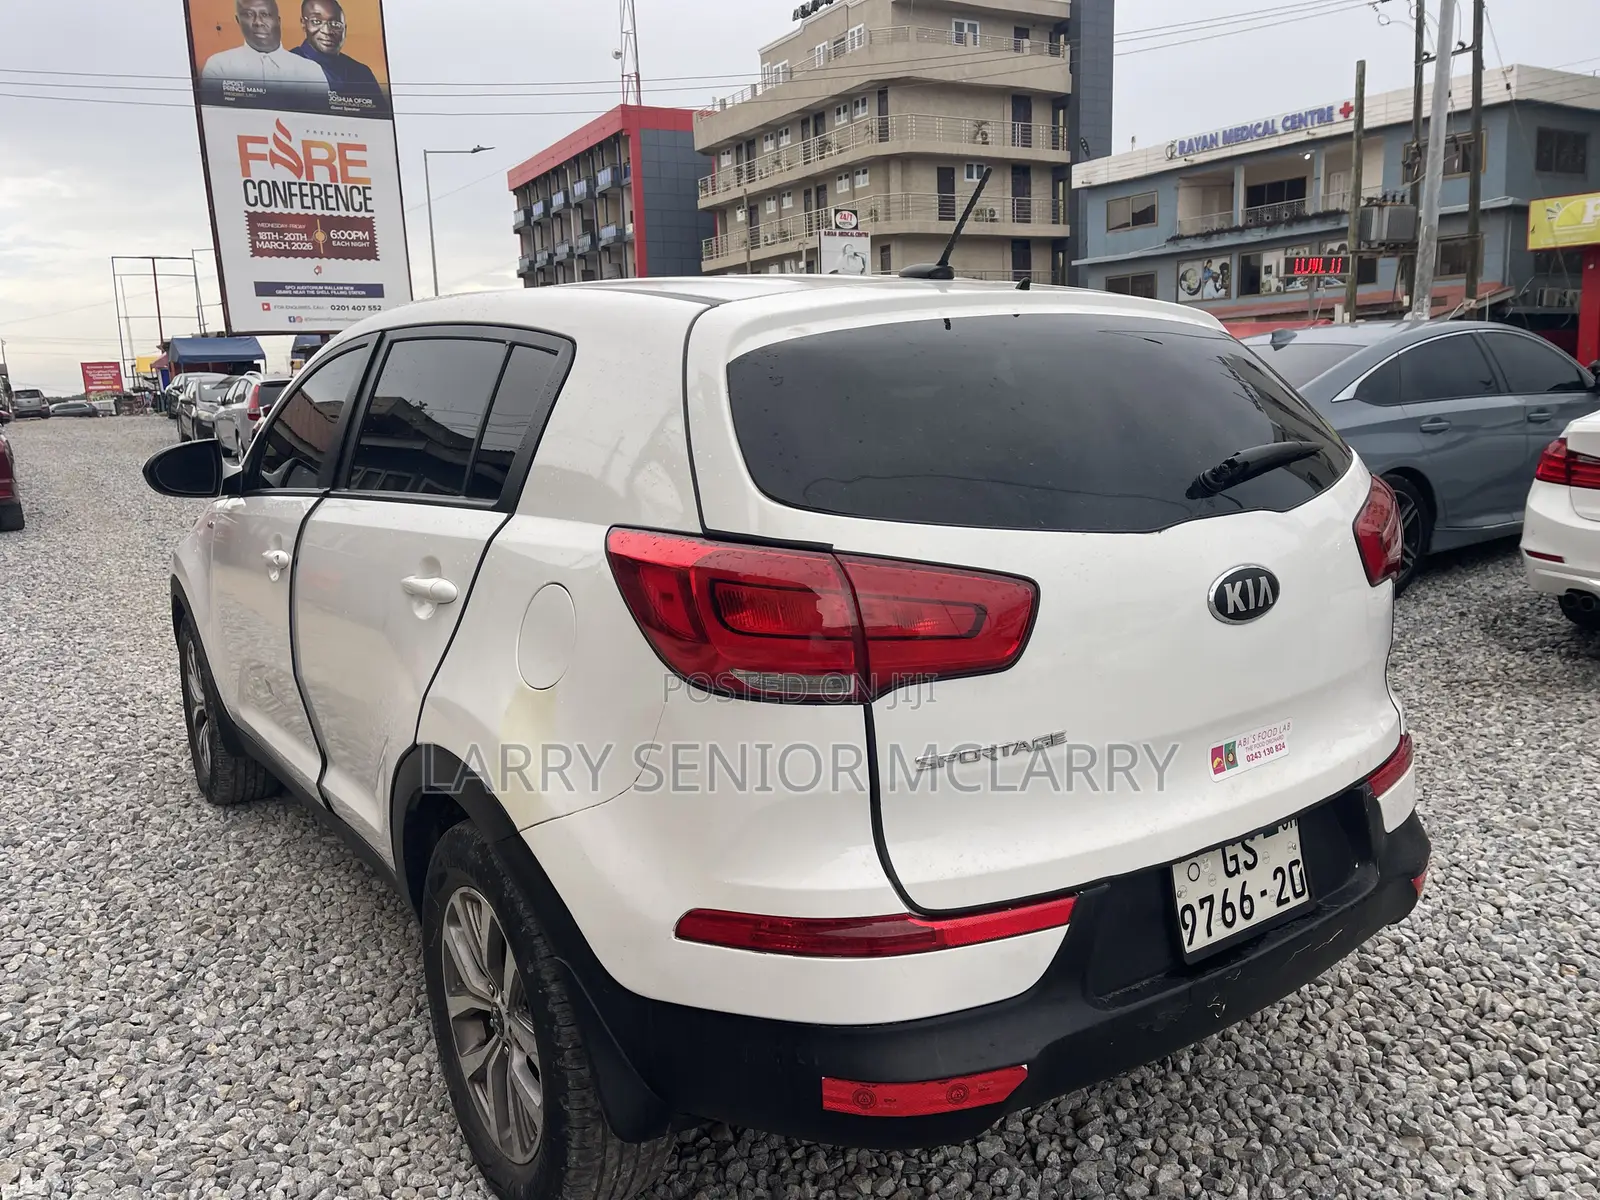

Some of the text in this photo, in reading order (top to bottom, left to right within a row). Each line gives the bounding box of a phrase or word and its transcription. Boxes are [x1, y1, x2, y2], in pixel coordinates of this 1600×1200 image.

[329, 95, 354, 103] JOSHUA
[353, 97, 373, 105] OFORI
[306, 129, 359, 138] PRESENTS
[1178, 105, 1335, 156] RAYAN MEDICAL CENTRE
[243, 179, 374, 212] CONFERENCE
[840, 213, 852, 221] 24/7
[330, 229, 370, 241] 6:00PM
[291, 242, 314, 251] 2026
[1223, 576, 1273, 614] KIA
[1257, 727, 1278, 741] FOOD
[1279, 721, 1291, 734] LAB
[914, 729, 1068, 772] SPORTAGE
[1246, 742, 1286, 762] 0243 130 824
[1254, 740, 1265, 749] FOOD
[1220, 839, 1259, 878] GS
[1180, 858, 1307, 947] 9766-20
